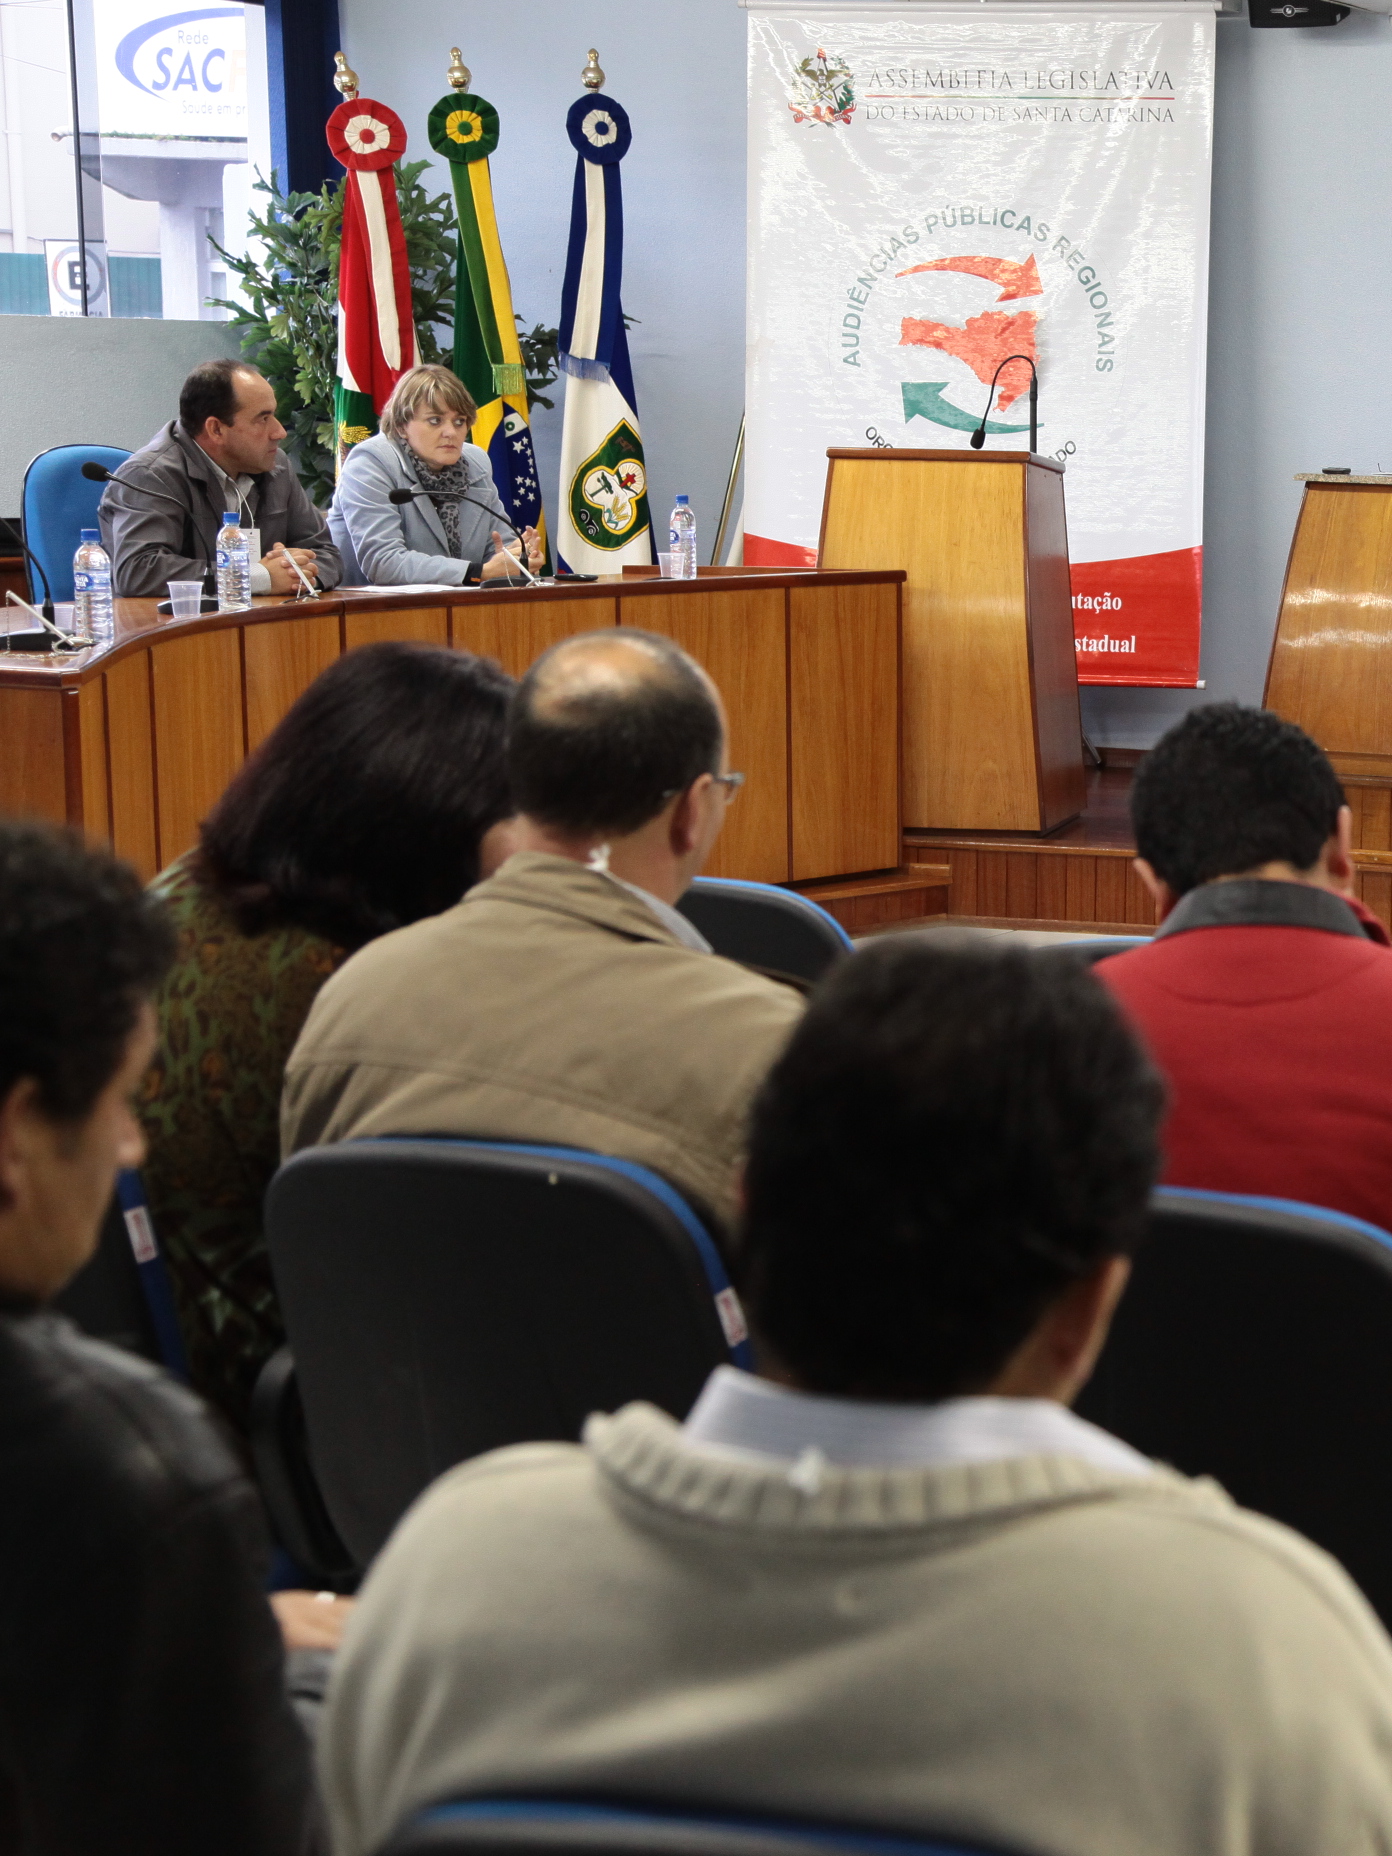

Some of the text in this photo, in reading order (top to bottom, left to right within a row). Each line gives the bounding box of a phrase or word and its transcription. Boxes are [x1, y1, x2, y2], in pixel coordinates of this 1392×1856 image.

[178, 30, 209, 45] Rede
[1024, 70, 1175, 90] LEGISLATIVA
[866, 105, 895, 120] DO
[903, 105, 975, 121] ESTADO
[982, 106, 1005, 121] DE
[1013, 107, 1073, 122] SANTA
[1079, 107, 1175, 123] CATARINA
[841, 204, 1116, 373] AUDIÊNCIAS PÚBLICAS REGIONAIS
